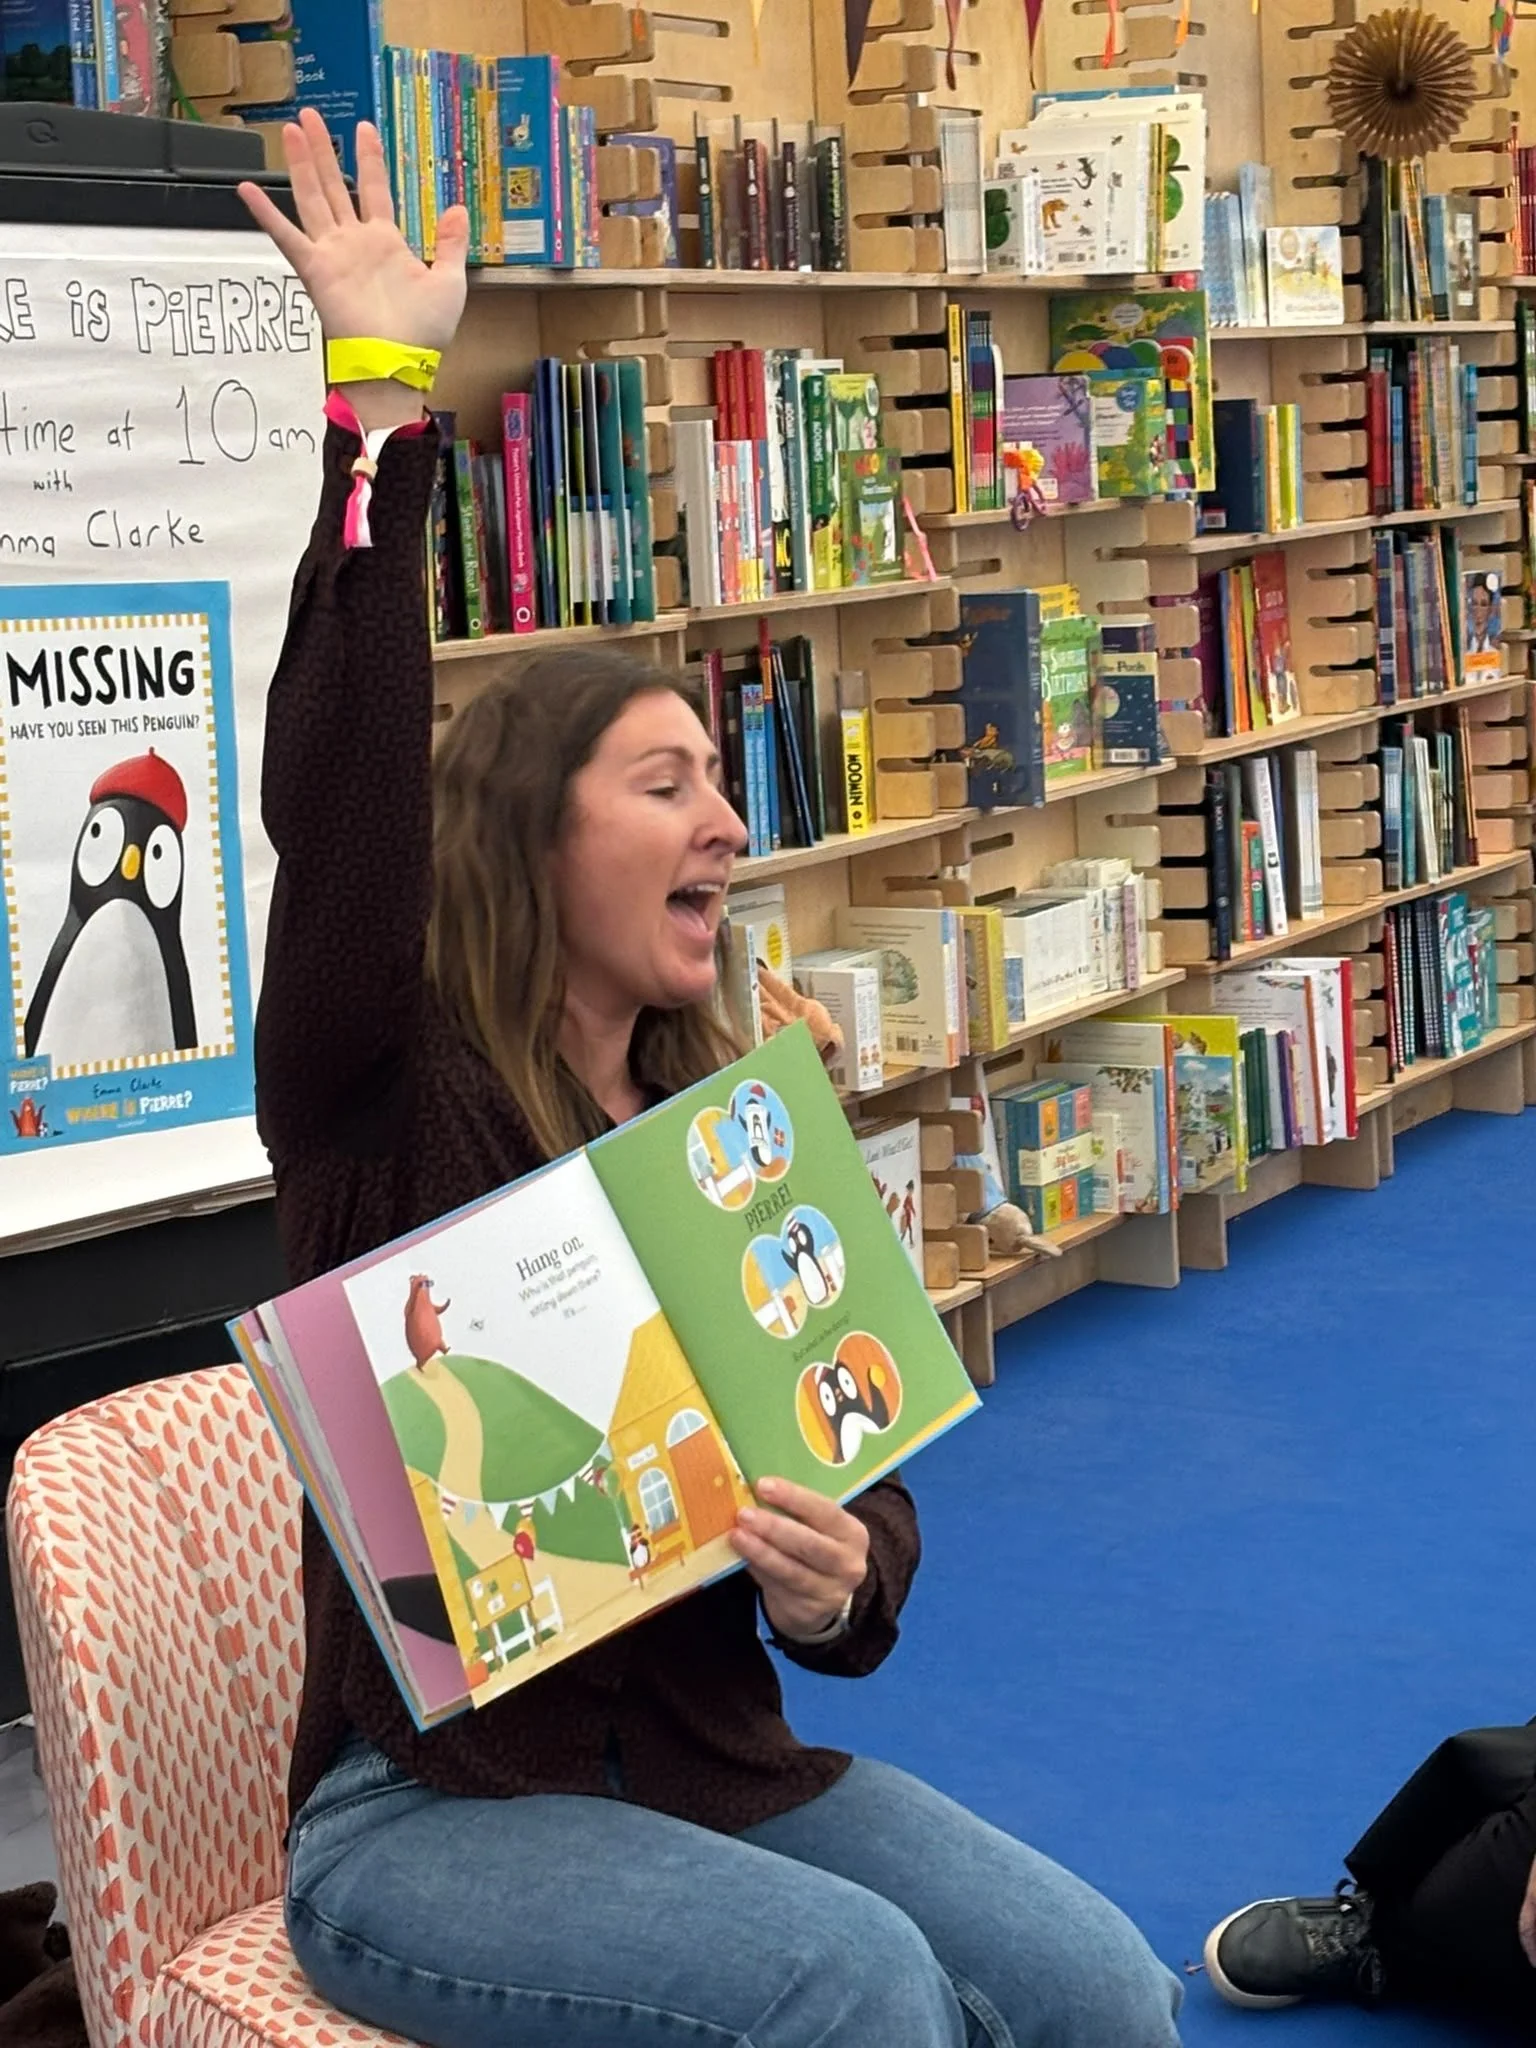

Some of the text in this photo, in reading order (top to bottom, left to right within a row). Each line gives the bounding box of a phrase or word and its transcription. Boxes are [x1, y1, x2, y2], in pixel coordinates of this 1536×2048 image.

[107, 410, 135, 450] at
[33, 469, 73, 492] with
[87, 509, 205, 549] Clarke
[6, 644, 195, 709] MISSING
[10, 713, 200, 740] HAVE YOU SEEN THIS PENGUIN?
[846, 753, 864, 806] MOOMIN
[515, 1247, 562, 1281] Hang
